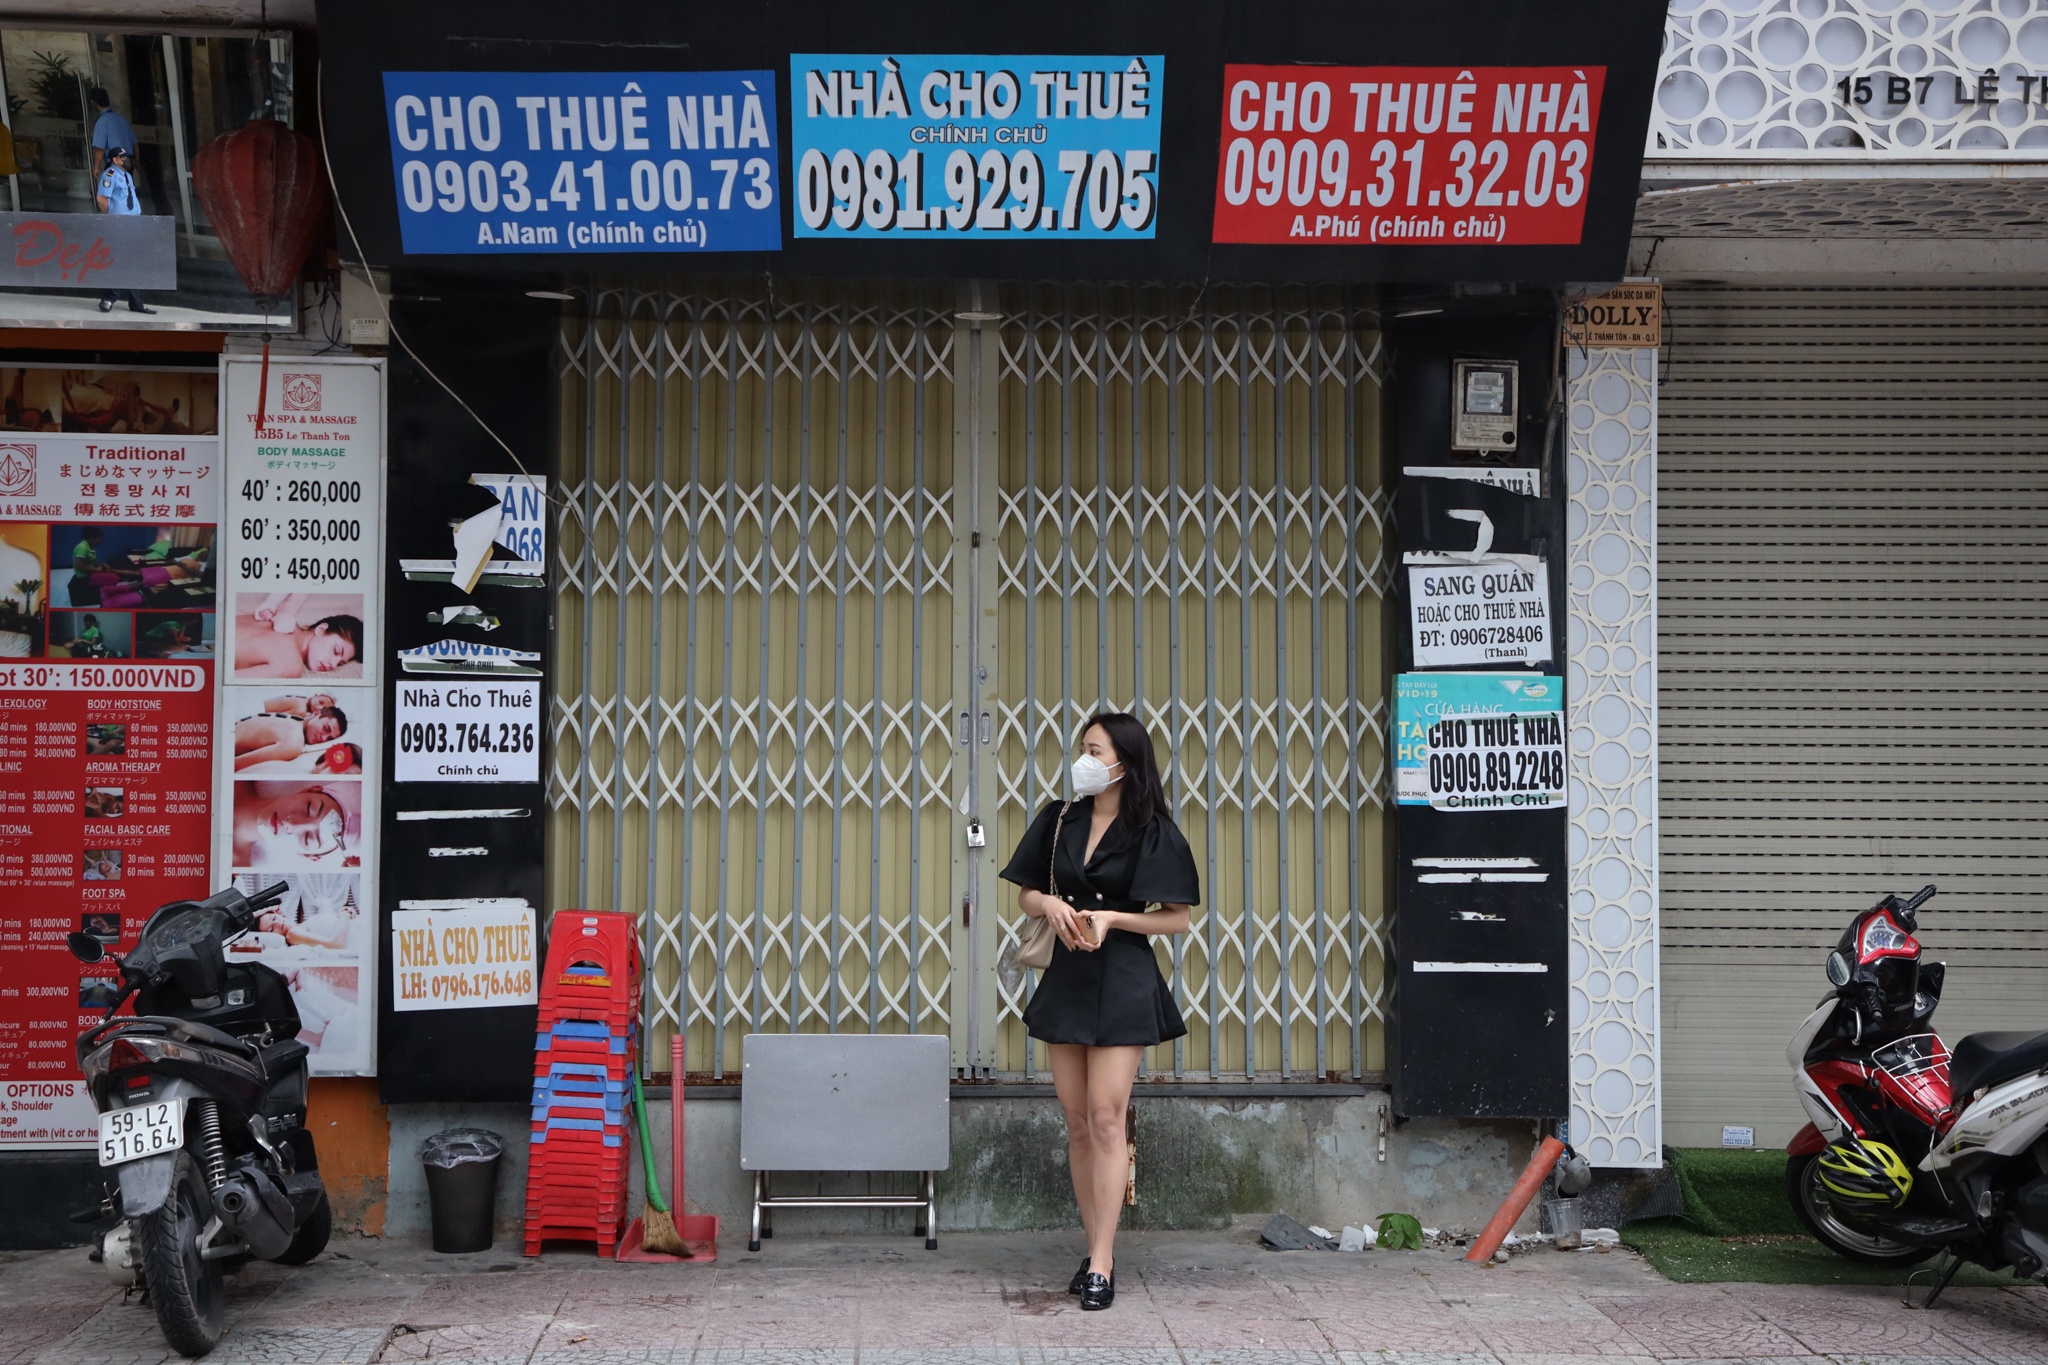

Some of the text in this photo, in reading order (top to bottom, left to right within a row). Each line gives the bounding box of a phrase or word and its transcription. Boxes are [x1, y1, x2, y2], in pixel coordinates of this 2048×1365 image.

[805, 56, 1151, 119] NHÀ CHO THUÊ
[1837, 76, 1873, 105] 15
[1887, 76, 1934, 105] B7
[1954, 68, 2000, 104] LÊ
[1229, 70, 1591, 134] CHO THUÊ NHÀ
[394, 80, 771, 152] CHO THUÊ NHÀ
[910, 123, 1048, 144] CHÍNH CHỦ
[1224, 137, 1589, 208] 0909.31.32.03
[402, 158, 773, 213] 0903.41.00.73
[798, 148, 1157, 231] 0981.929.705
[478, 218, 707, 249] A.Nam (chính chủ)
[1290, 213, 1506, 242] A.Phú (chính chủ)
[13, 220, 115, 282] Đẹp
[1572, 305, 1652, 326] DOLLY
[277, 416, 296, 424] SPA
[300, 416, 306, 424] &
[310, 416, 357, 424] MASSAGE
[286, 432, 298, 440] Le
[300, 432, 330, 440] Thanh
[332, 432, 350, 440] Ton
[86, 446, 185, 460] Traditional
[258, 447, 346, 457] BODY MASSAGE
[60, 464, 210, 479] まじめなマッサージ
[267, 461, 336, 470] ボディマッサージ
[287, 480, 361, 506] 260,000
[16, 505, 62, 516] MASSAGE
[287, 519, 360, 545] 350,000
[286, 558, 360, 584] 450,000
[1424, 569, 1534, 600] SANG QUÁN
[1418, 598, 1546, 627] HOẶC CHO THUÊ NHÀ
[1420, 626, 1544, 648] ĐT: 0906728406
[1484, 646, 1528, 659] (Thanh)
[69, 668, 196, 688] 150.000VND
[403, 689, 532, 708] Nhà Cho Thuê
[88, 700, 162, 710] BODY HOTSTONE
[10, 722, 76, 732] mins 180,000VND
[130, 724, 208, 734] 60 mins 350,000VND
[1428, 720, 1467, 748] CHO
[1471, 714, 1519, 747] THUÊ
[1524, 712, 1562, 746] NHÀ
[10, 736, 76, 746] mins 280,000VND
[130, 736, 208, 746] 90 mins 450,000VND
[400, 722, 534, 754] 0903.764.236
[10, 748, 76, 758] mins 340,000VND
[126, 749, 207, 759] 120 mins 550,000VND
[86, 762, 161, 772] AROMA THERAPY
[438, 764, 499, 776] Chính chủ
[1430, 750, 1564, 793] 0909.89.2248
[8, 791, 75, 801] mins 380,000VND
[129, 792, 206, 802] 60 mins 350,000VND
[1447, 794, 1550, 808] Chính Chủ
[8, 804, 74, 814] mins 500,000VND
[128, 804, 206, 814] 90 mins 450,000VND
[84, 825, 170, 834] FACIAL BASIC CARE
[31, 854, 74, 864] 380,000VND
[128, 854, 204, 864] 30 mins 200,000VND
[30, 868, 73, 878] 500,000VND
[127, 867, 204, 878] 60 mins 350,000VND
[82, 889, 126, 898] FOOT SPA
[29, 918, 72, 928] 180,000VND
[399, 914, 532, 968] NHÀ CHO THUÊ
[400, 970, 532, 1000] LH: 0796.176.648
[26, 987, 69, 997] 300,000VND
[29, 1021, 68, 1030] 80,000VND
[28, 1040, 67, 1050] 80,000VND
[28, 1062, 66, 1070] 80,000VND
[7, 1084, 74, 1098] OPTIONS
[11, 1101, 54, 1110] Shoulder
[30, 1128, 86, 1140] with (vit or
[105, 1126, 176, 1160] 516.64
